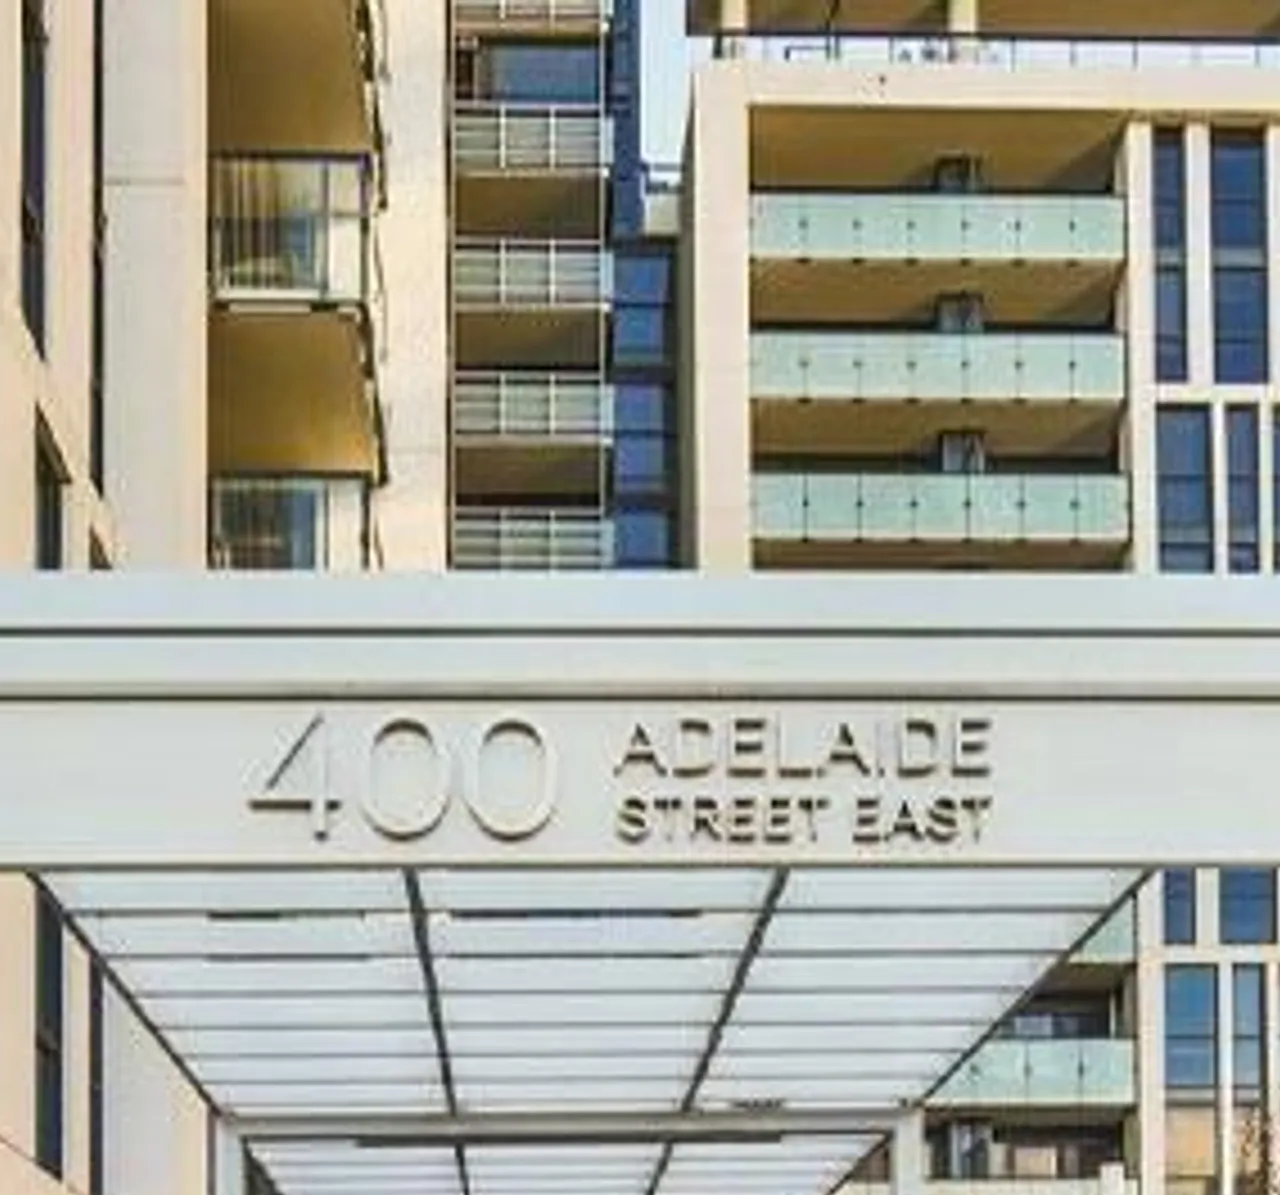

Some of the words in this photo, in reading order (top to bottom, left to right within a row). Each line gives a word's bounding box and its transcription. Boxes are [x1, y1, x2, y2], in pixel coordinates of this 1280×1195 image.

[246, 712, 558, 842] 400
[612, 717, 992, 778] ADELAIDE
[614, 798, 829, 845] STREET
[850, 798, 993, 845] EAST
